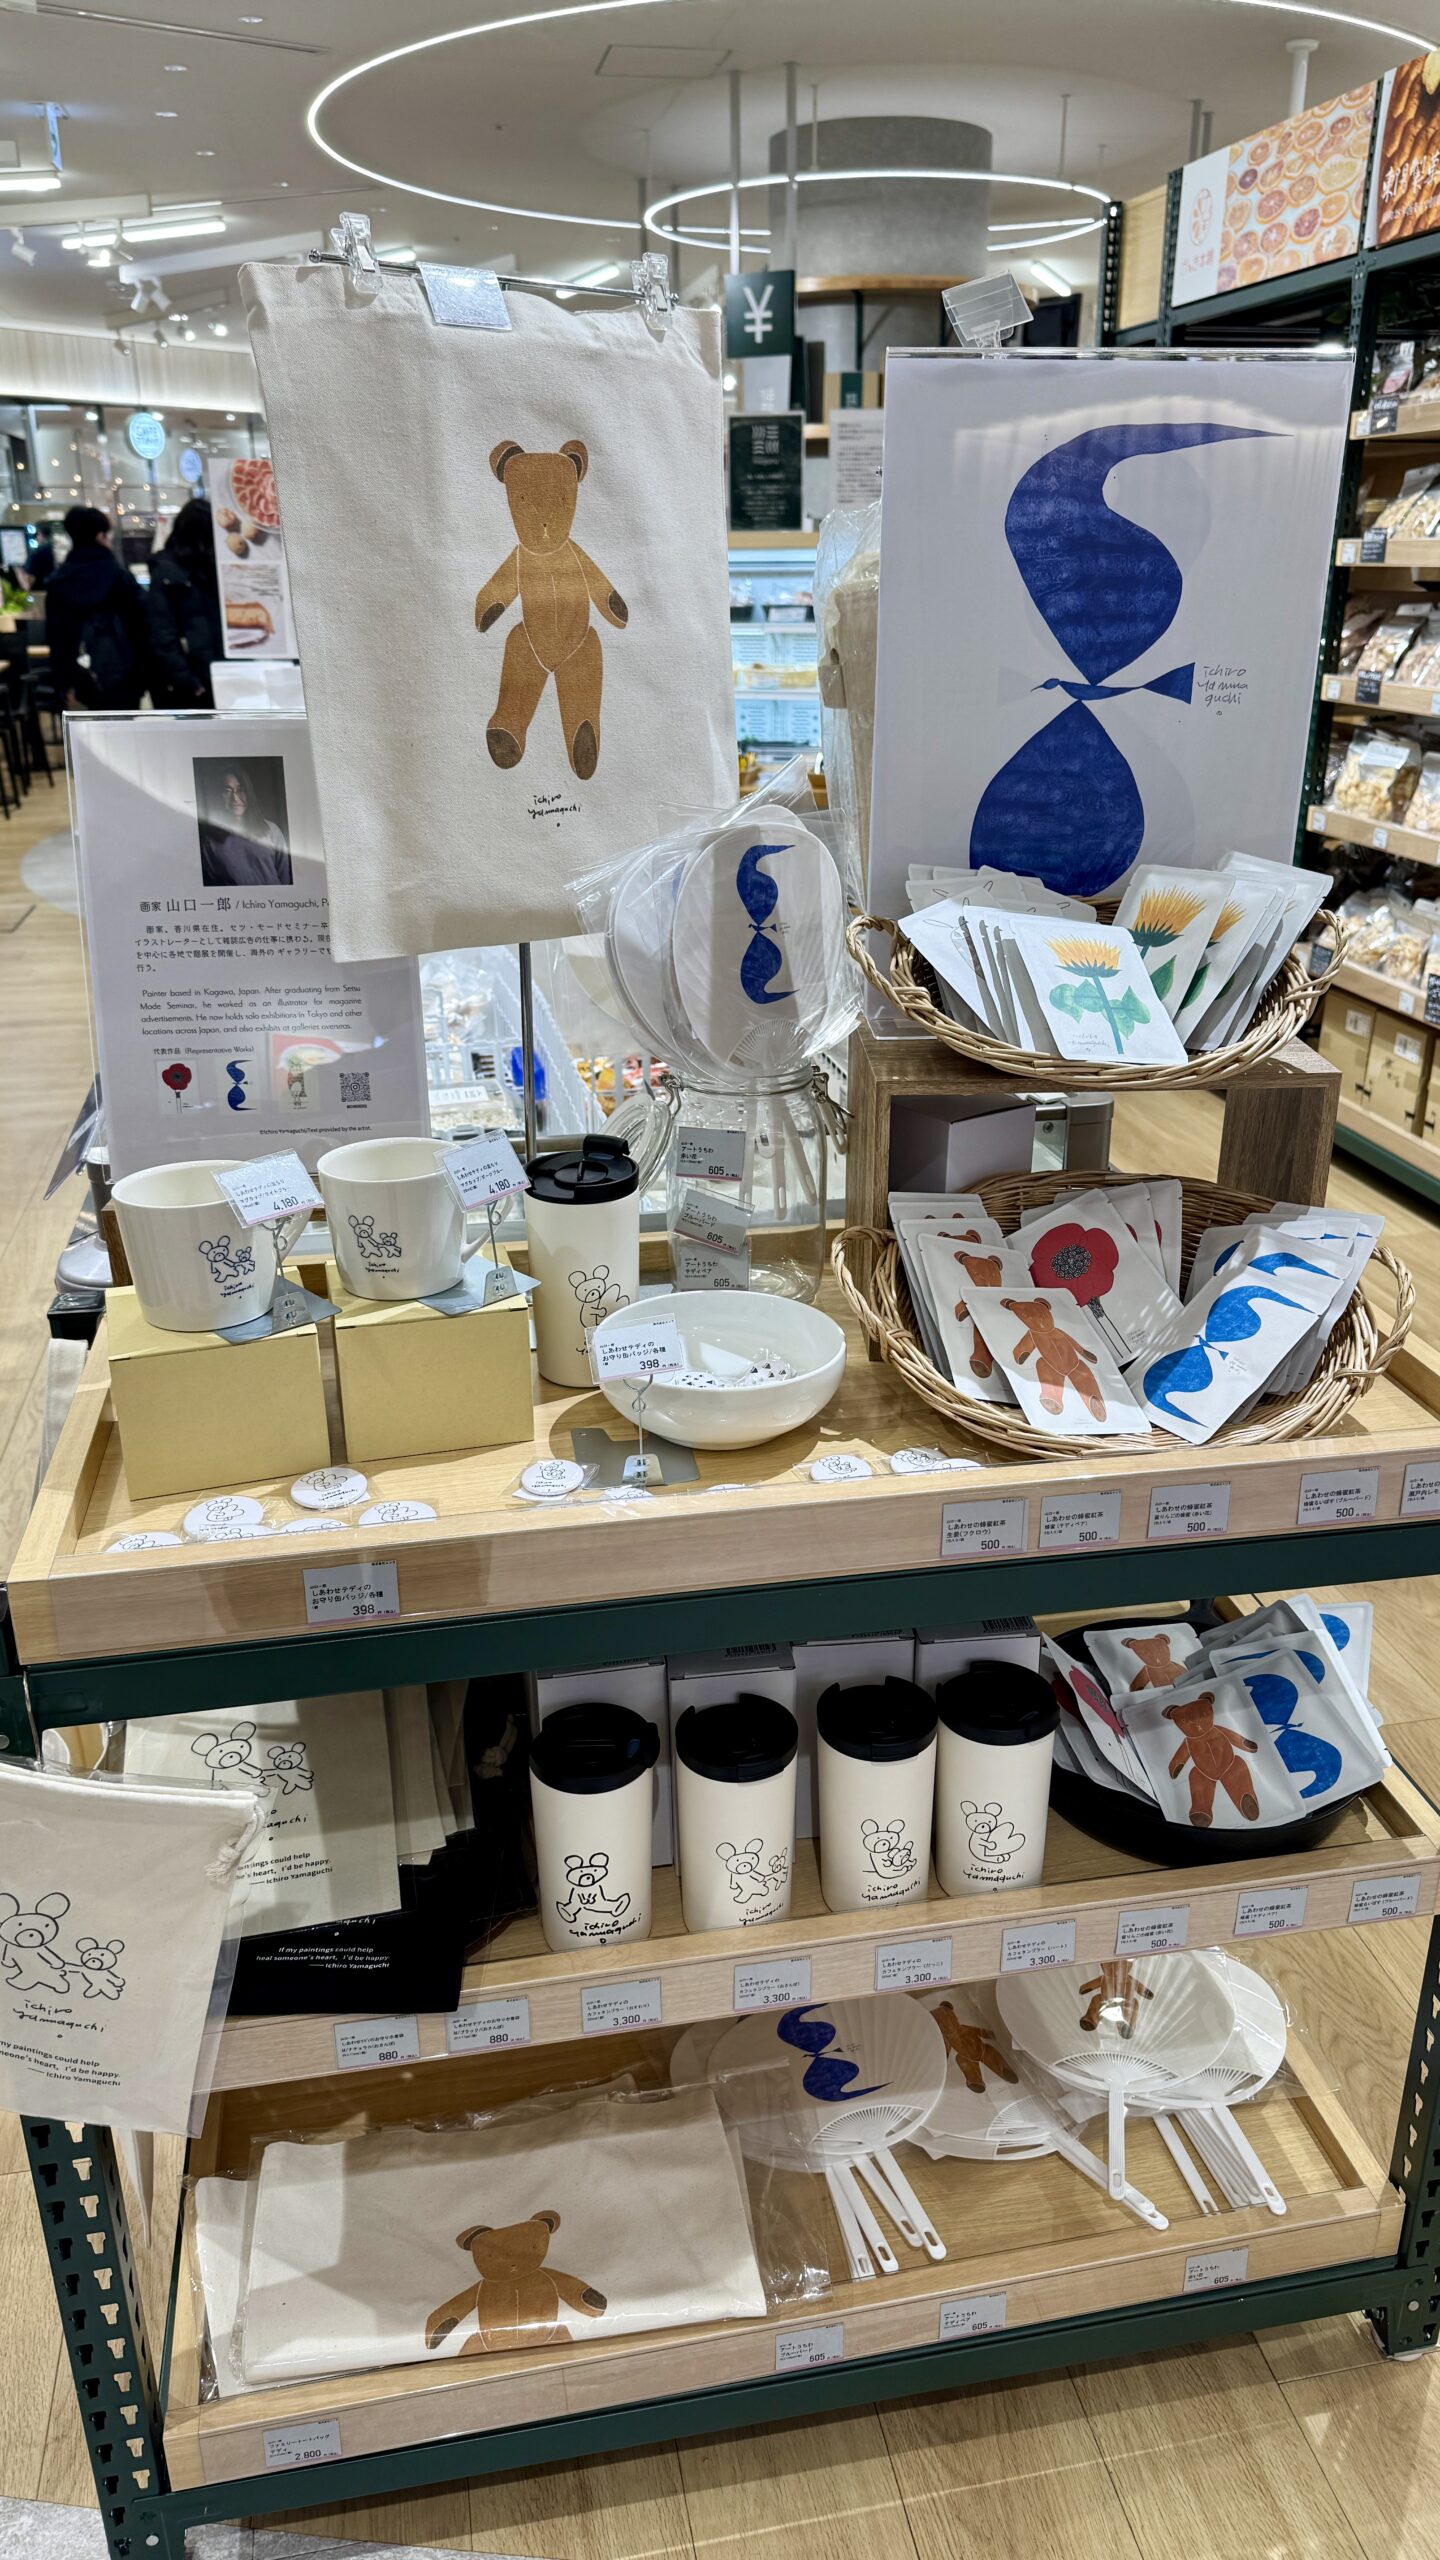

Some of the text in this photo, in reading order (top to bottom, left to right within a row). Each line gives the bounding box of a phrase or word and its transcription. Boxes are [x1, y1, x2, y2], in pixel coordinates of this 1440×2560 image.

[140, 901, 161, 912] 画家
[167, 897, 231, 912] 山口一郎
[243, 900, 266, 909] Ichiro
[268, 897, 319, 911] Yamaguchi,
[170, 989, 192, 997] based
[204, 988, 236, 998] Kagawa,
[285, 986, 322, 995] graduating
[167, 1002, 197, 1010] Seminar,
[218, 1000, 243, 1008] worked
[329, 998, 362, 1006] magazine
[142, 1015, 194, 1023] advertisements.
[307, 1011, 327, 1019] Tokyo
[199, 1026, 221, 1035] Japan,
[255, 1024, 280, 1032] exhibits
[292, 1023, 319, 1031] galleries
[707, 1165, 725, 1175] 605
[705, 1231, 723, 1244] 605
[713, 1277, 730, 1287] 605
[638, 1357, 660, 1370] 398
[1335, 1506, 1354, 1518] 500
[1186, 1521, 1206, 1533] 500
[1078, 1530, 1098, 1542] 500
[980, 1538, 1000, 1550] 500
[311, 1583, 371, 1597] しあわせテディの
[351, 1603, 375, 1616] 398
[271, 1852, 310, 1865] could help
[253, 1869, 276, 1877] heart,
[266, 1866, 333, 1884] Ichiro Yamaguchi
[1380, 1906, 1398, 1916] 500
[1268, 1918, 1285, 1928] 500
[1150, 1938, 1167, 1948] 500
[489, 2032, 508, 2044] 880
[13, 2043, 53, 2059] paintings
[55, 2055, 78, 2064] could
[80, 2059, 100, 2067] help
[378, 2050, 398, 2061] 880
[34, 2058, 59, 2070] heart,
[92, 2069, 120, 2078] happy.
[46, 2072, 120, 2086] Ichiro Yamaguchi
[1213, 2275, 1229, 2284] 605
[971, 2321, 987, 2330] 605
[809, 2352, 825, 2362] 605
